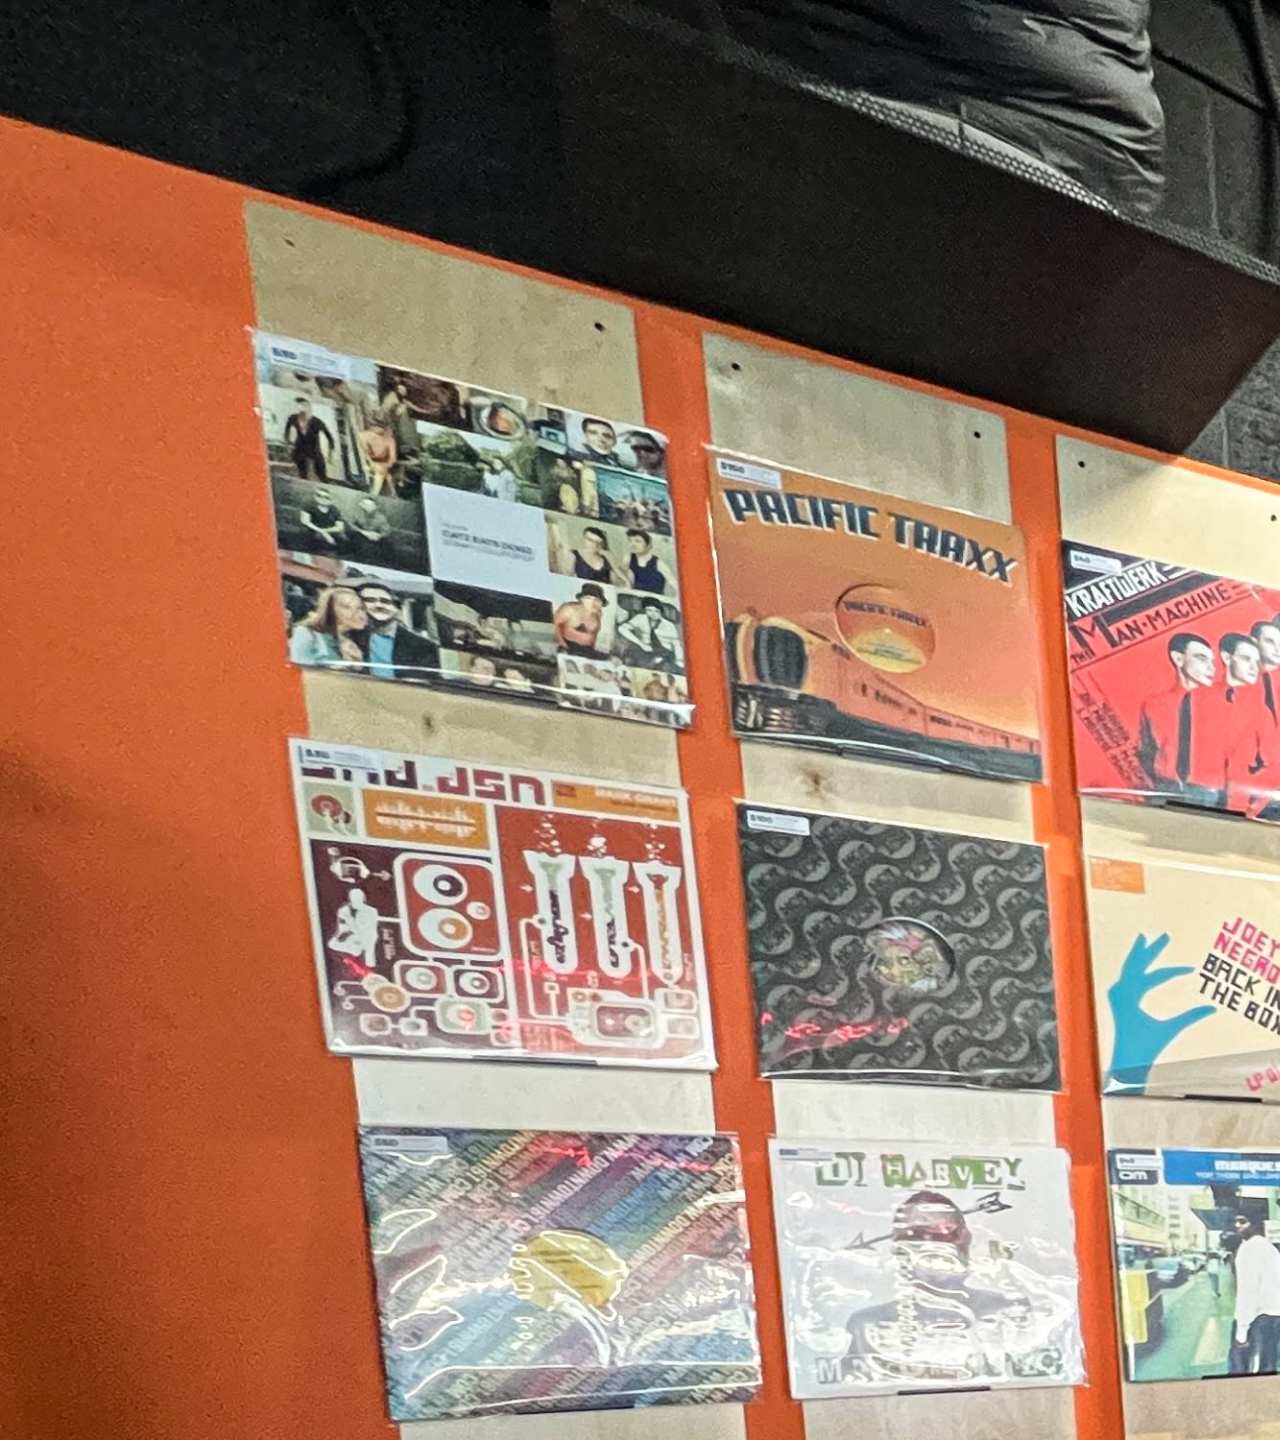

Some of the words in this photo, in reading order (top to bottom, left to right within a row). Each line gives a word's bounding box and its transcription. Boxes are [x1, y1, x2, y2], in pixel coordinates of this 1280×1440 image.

[721, 489, 881, 539] PACIFIC
[886, 512, 1018, 588] TRAXX
[1066, 560, 1168, 617] KRAFTWERK
[1199, 973, 1242, 1012] THE
[1202, 953, 1261, 996] BACK
[881, 1154, 1026, 1190] HARVEY
